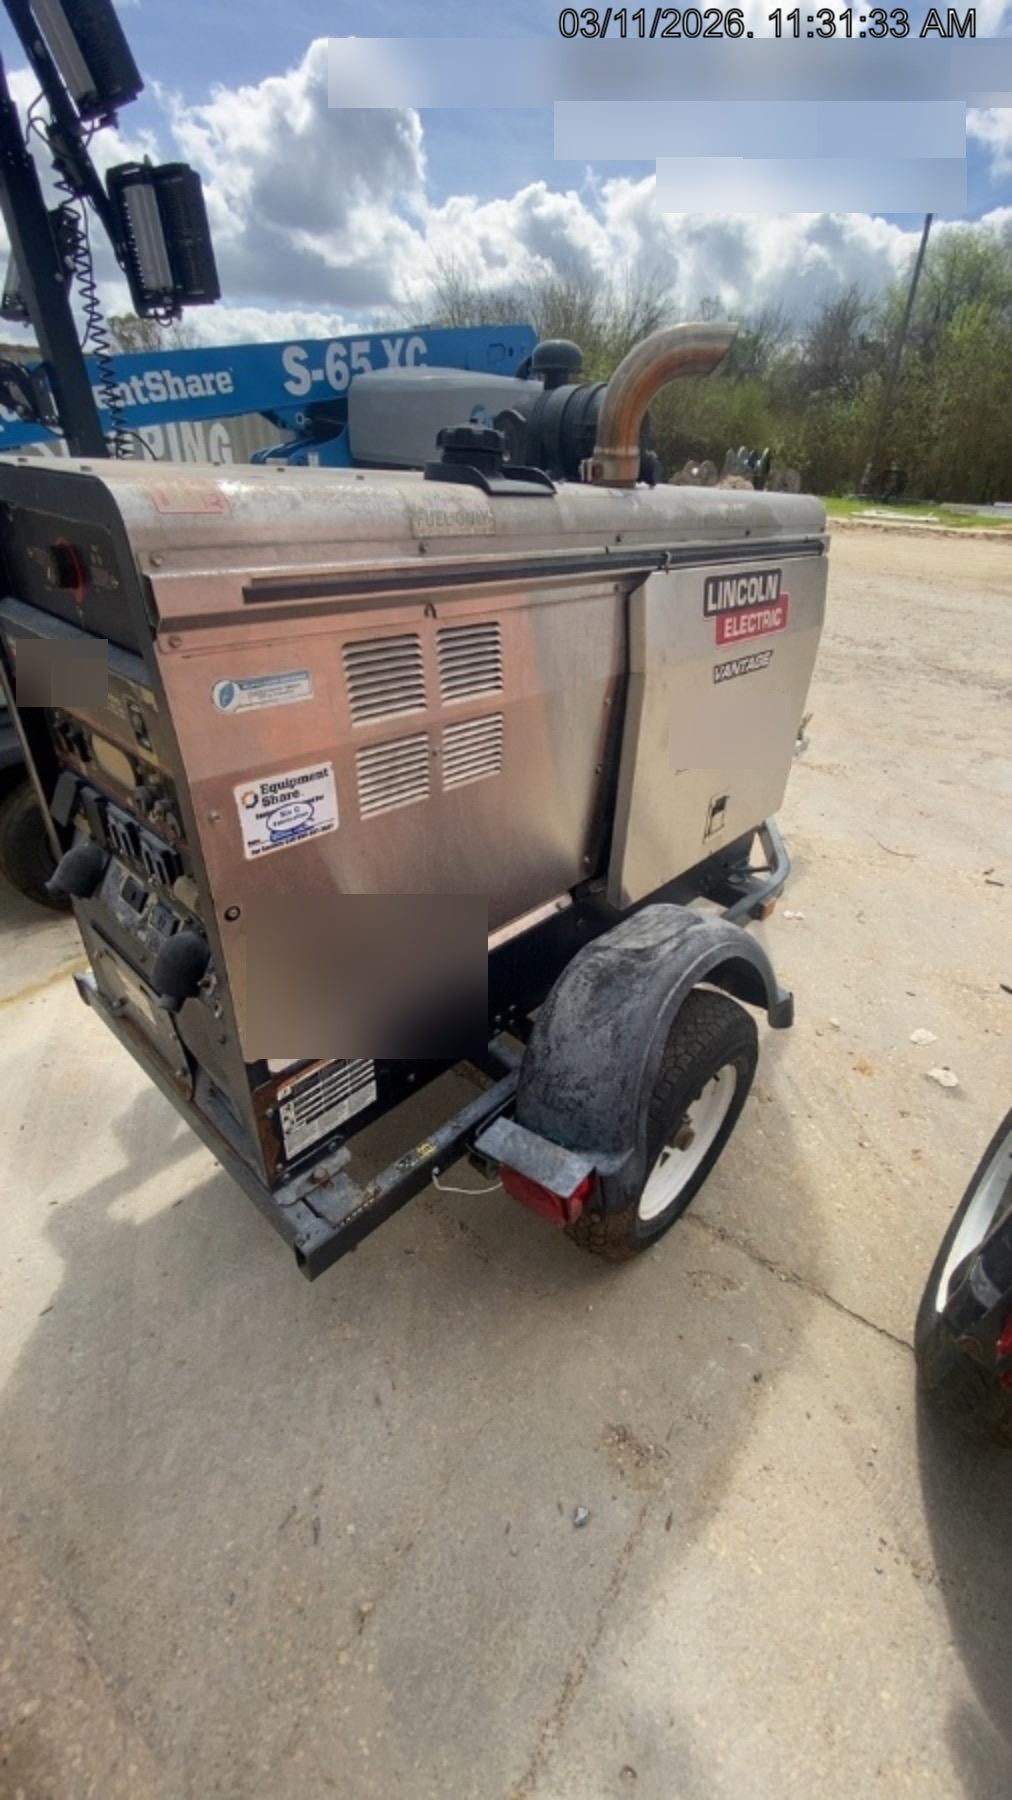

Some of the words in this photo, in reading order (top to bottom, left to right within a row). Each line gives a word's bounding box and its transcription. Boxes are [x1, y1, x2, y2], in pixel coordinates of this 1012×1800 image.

[92, 366, 234, 410] entShare
[282, 341, 373, 396] S-65
[706, 573, 779, 612] LINCOLN
[723, 607, 783, 639] ELECTRIC
[714, 654, 771, 681] VANTAGE
[260, 768, 329, 795] Equipment
[261, 790, 300, 807] Share
